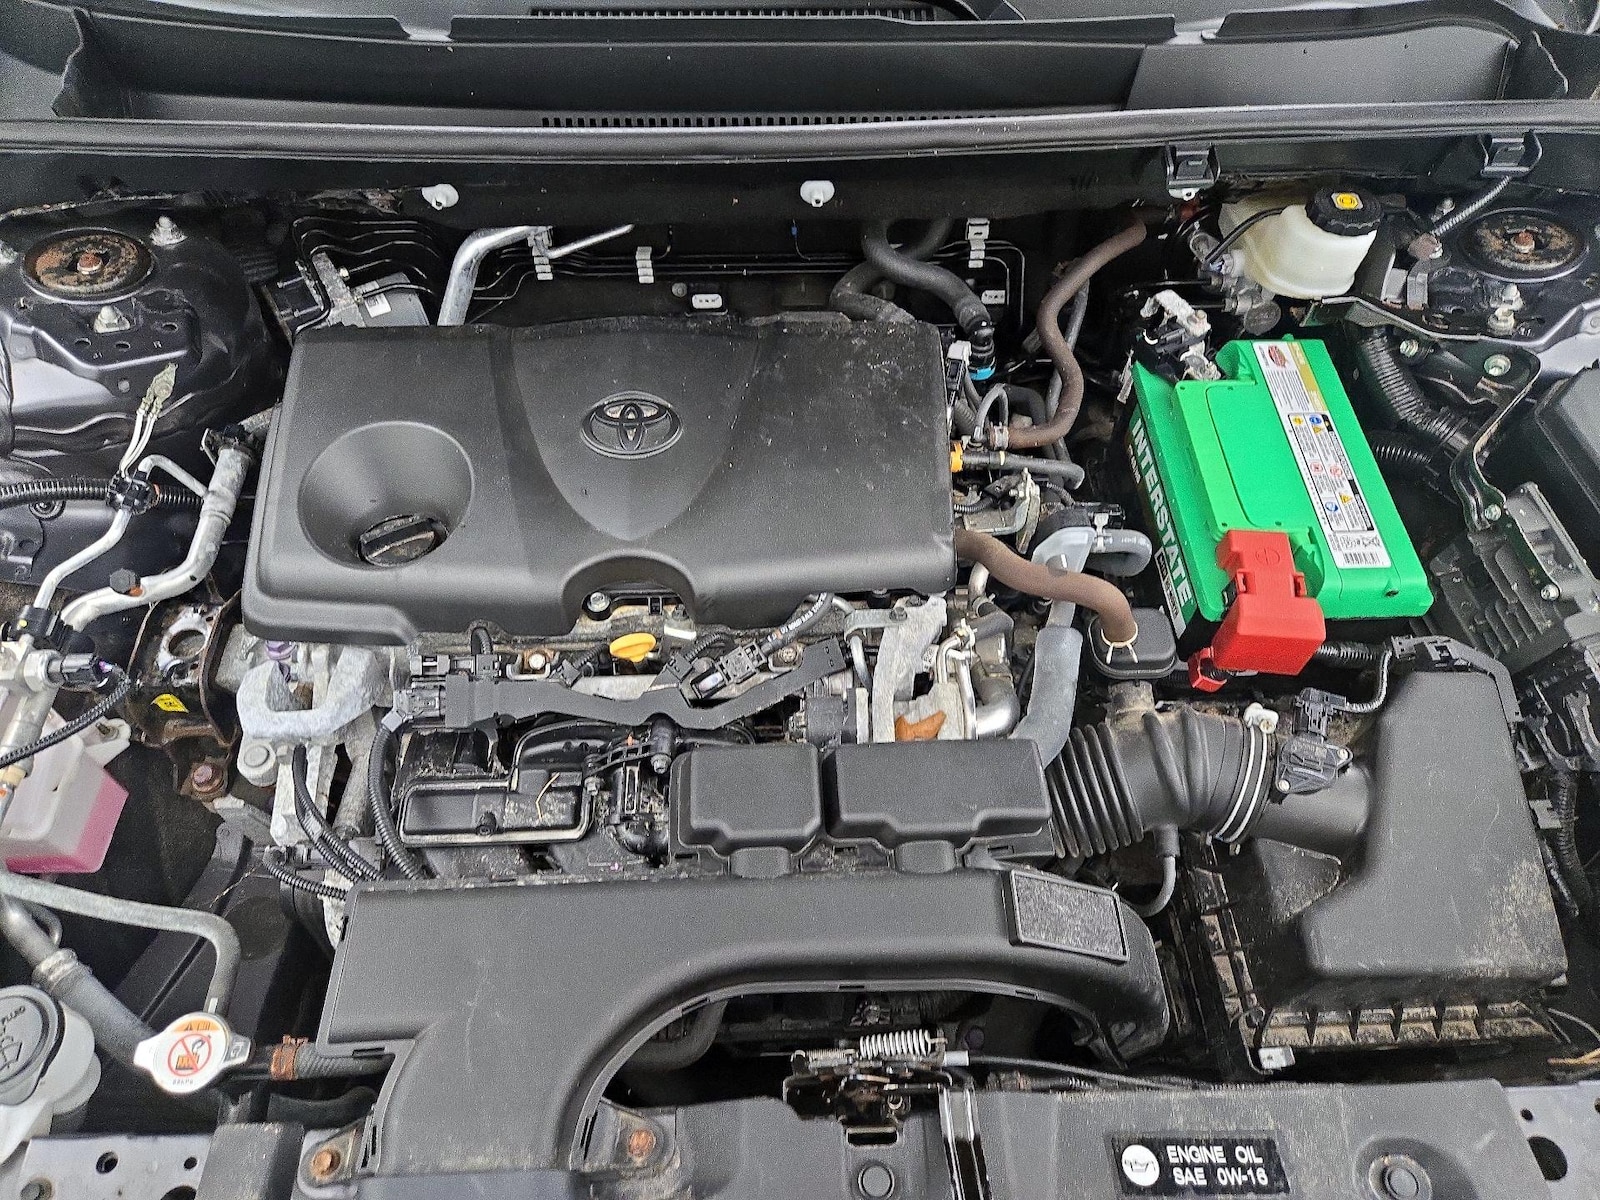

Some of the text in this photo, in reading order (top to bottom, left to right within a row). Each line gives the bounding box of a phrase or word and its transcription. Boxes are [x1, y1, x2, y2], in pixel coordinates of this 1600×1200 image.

[1132, 417, 1193, 607] INTERSTATE
[1166, 1145, 1263, 1164] ENGINE OIL
[1172, 1167, 1208, 1186] SAE
